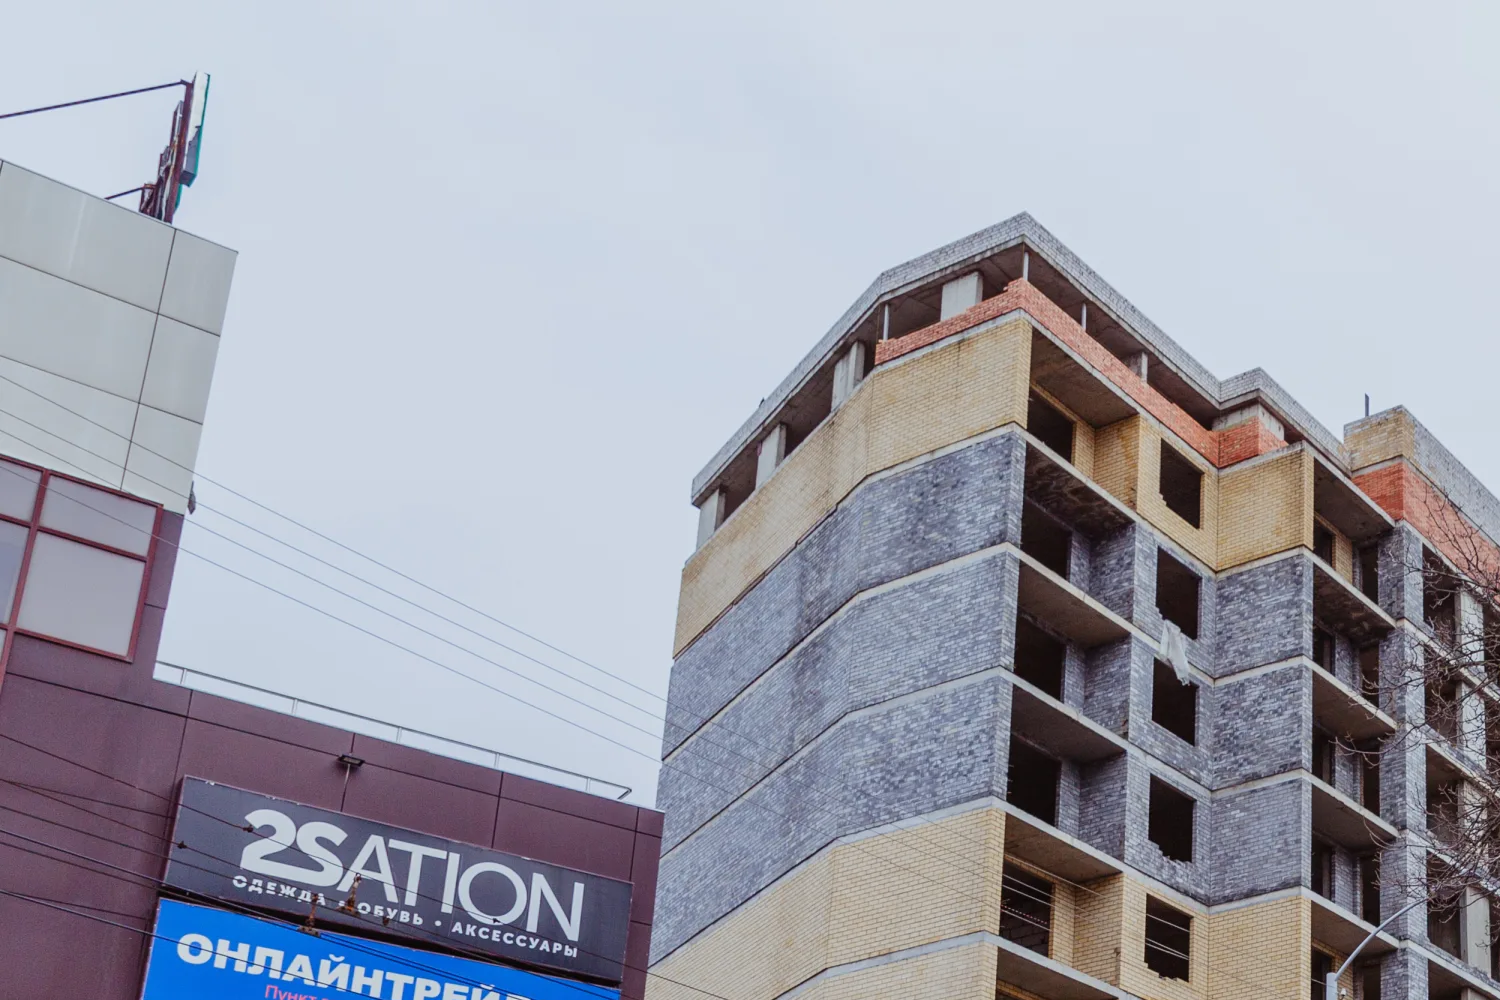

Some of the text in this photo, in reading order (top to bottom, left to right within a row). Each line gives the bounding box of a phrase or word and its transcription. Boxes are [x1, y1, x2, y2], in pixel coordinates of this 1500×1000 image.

[232, 875, 578, 958] ОДЕЖДА ОБУВЬ АКСЕССУАРЫ
[240, 809, 584, 942] 2SATION
